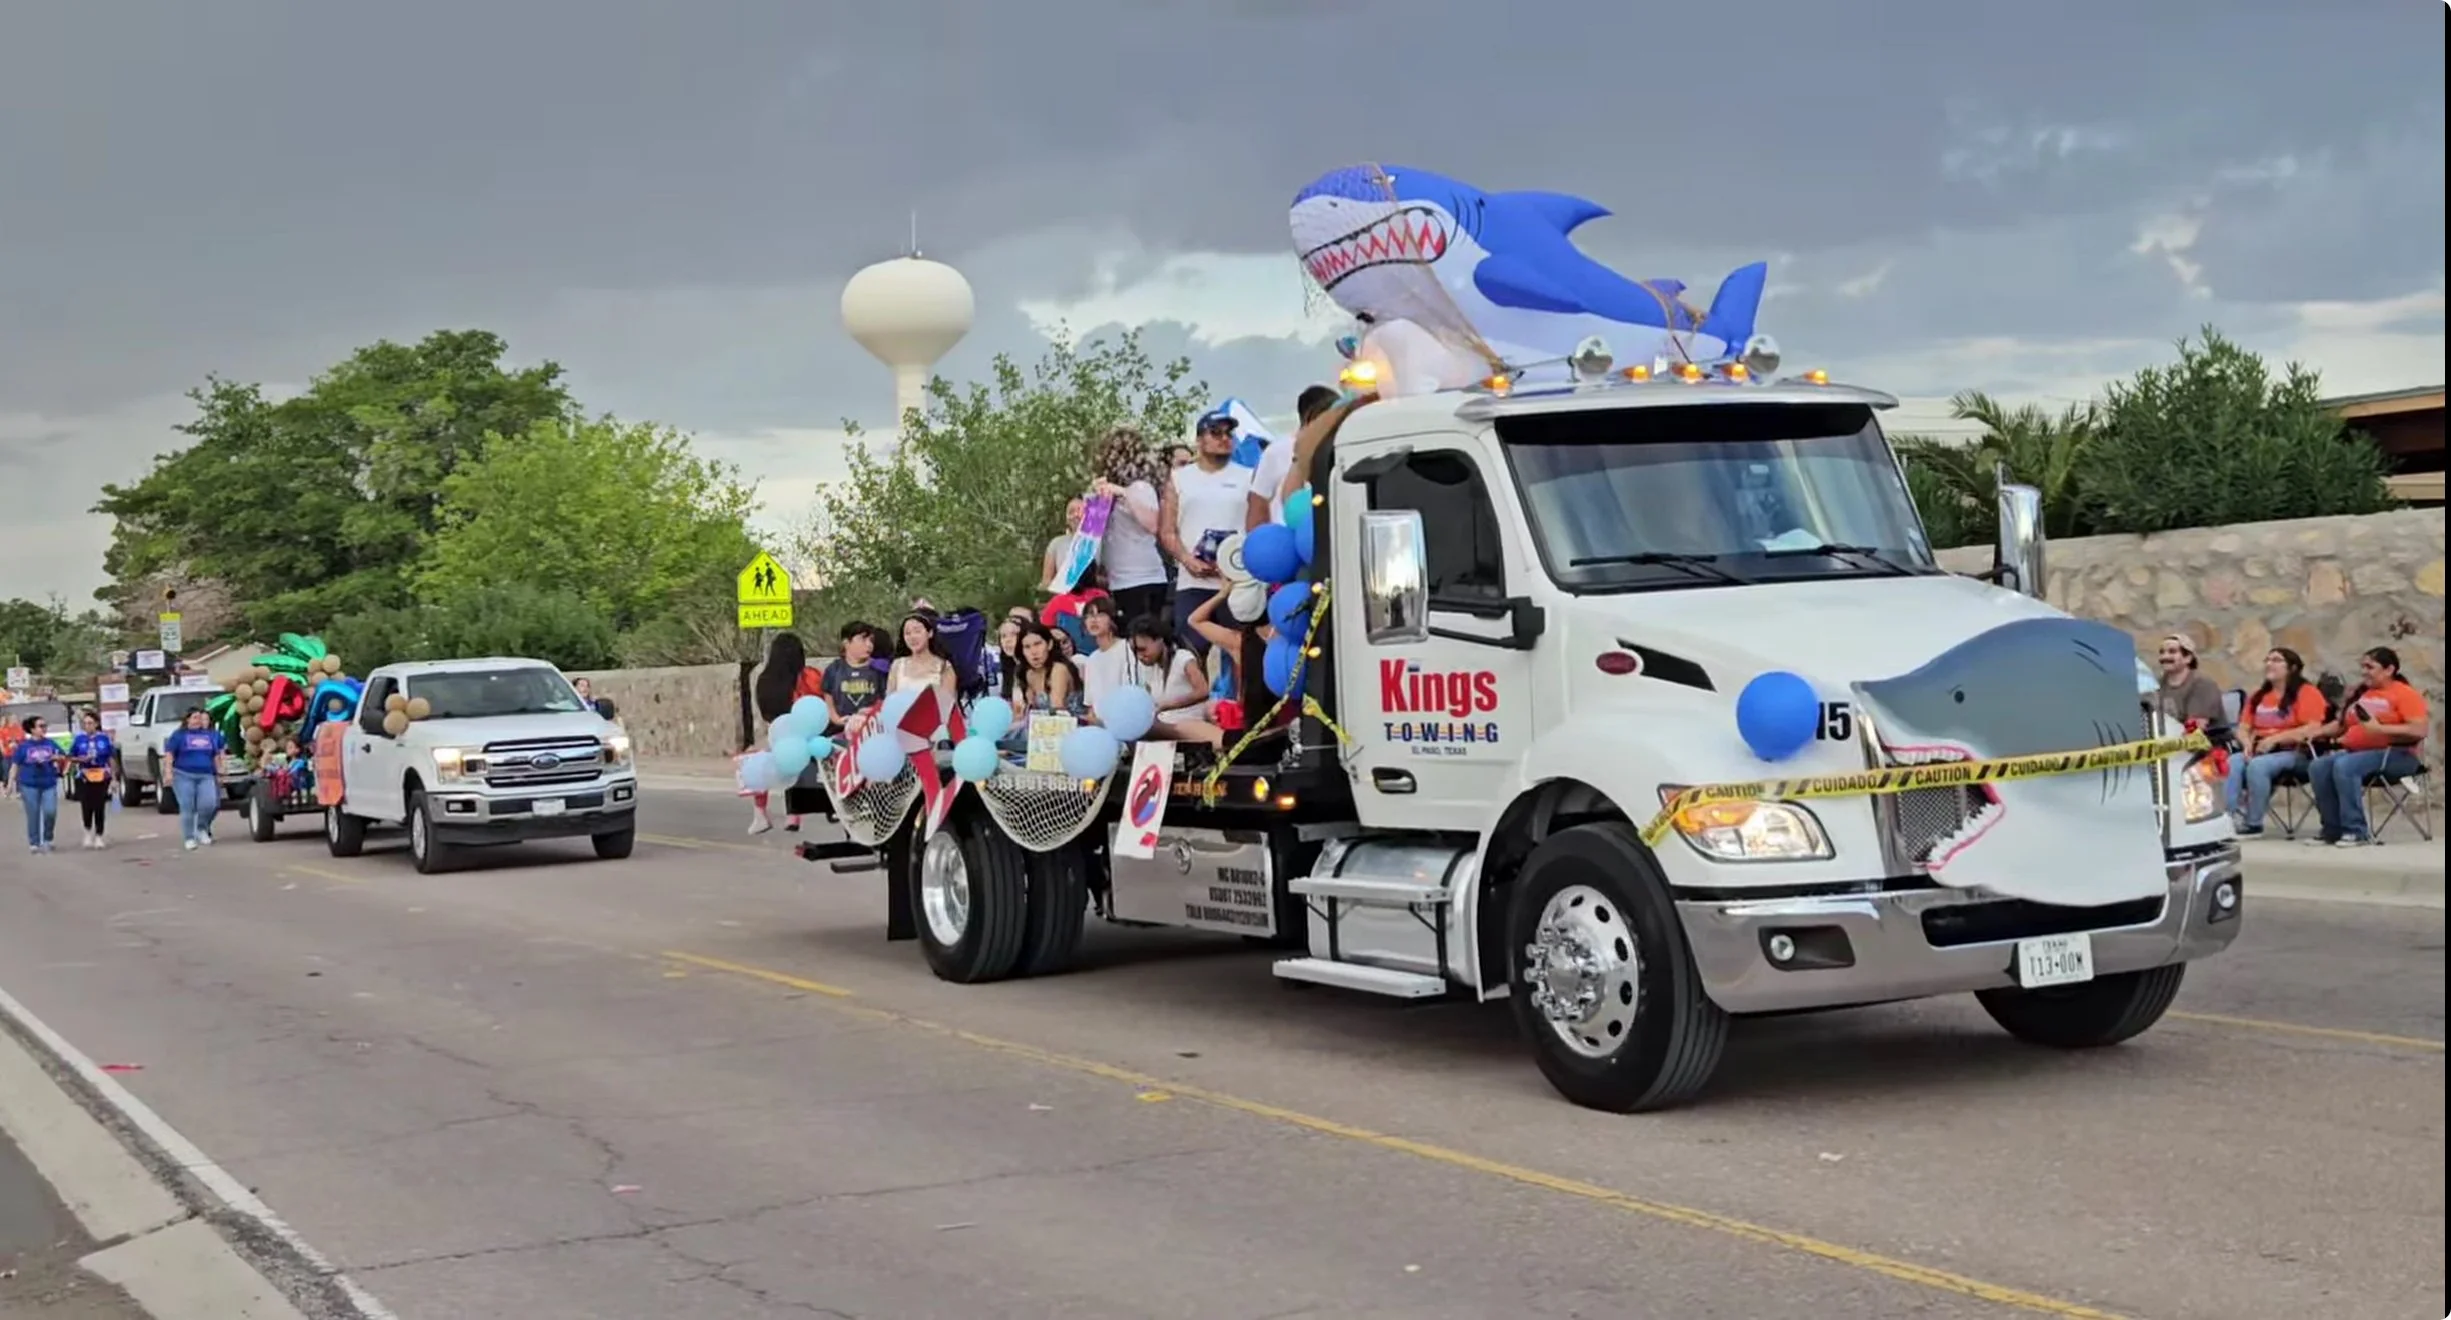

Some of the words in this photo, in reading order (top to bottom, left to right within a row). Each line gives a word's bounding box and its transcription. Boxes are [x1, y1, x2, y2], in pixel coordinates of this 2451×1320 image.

[743, 609, 789, 621] AHEAD
[1380, 658, 1498, 718] Kings
[1384, 722, 1499, 742] TOWING
[1444, 747, 1467, 756] TEXAS
[1706, 783, 1766, 799] CAUTION
[1812, 773, 1878, 793] CUIDADO
[1914, 767, 1972, 785] CAUTION
[2010, 757, 2061, 777] CUIDADO
[2089, 751, 2131, 767] CAUTION
